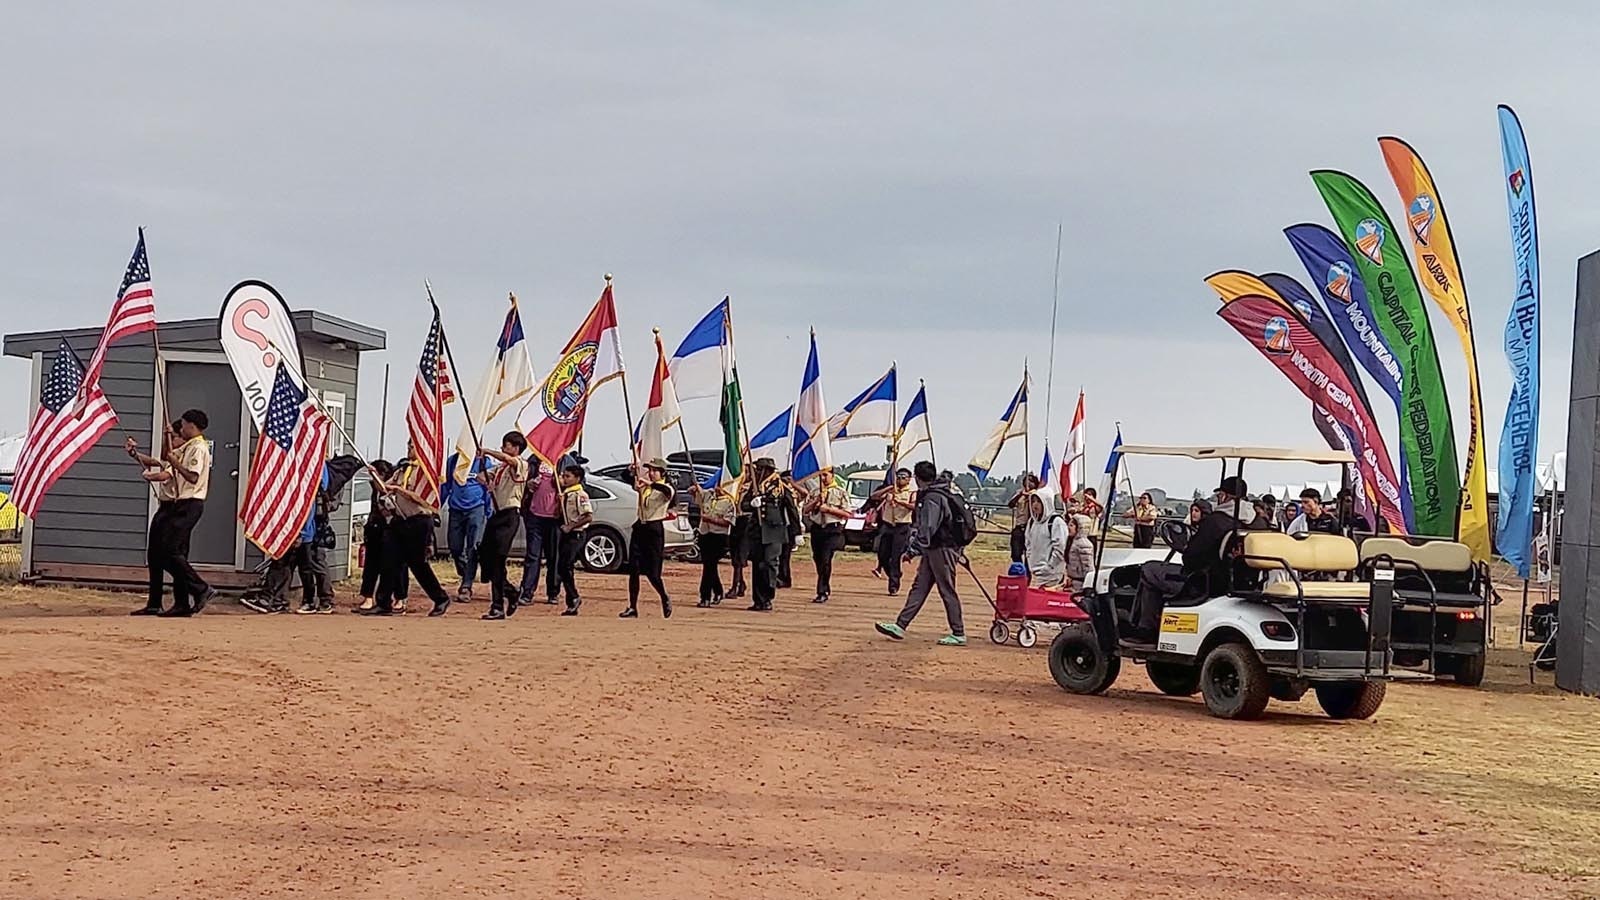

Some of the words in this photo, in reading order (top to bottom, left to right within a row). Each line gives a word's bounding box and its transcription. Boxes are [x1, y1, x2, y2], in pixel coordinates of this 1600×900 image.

[1422, 254, 1453, 294] ARK
[1291, 349, 1328, 389] NORTH
[1377, 271, 1418, 346] CAPITAL
[1409, 399, 1442, 520] FEDERATION
